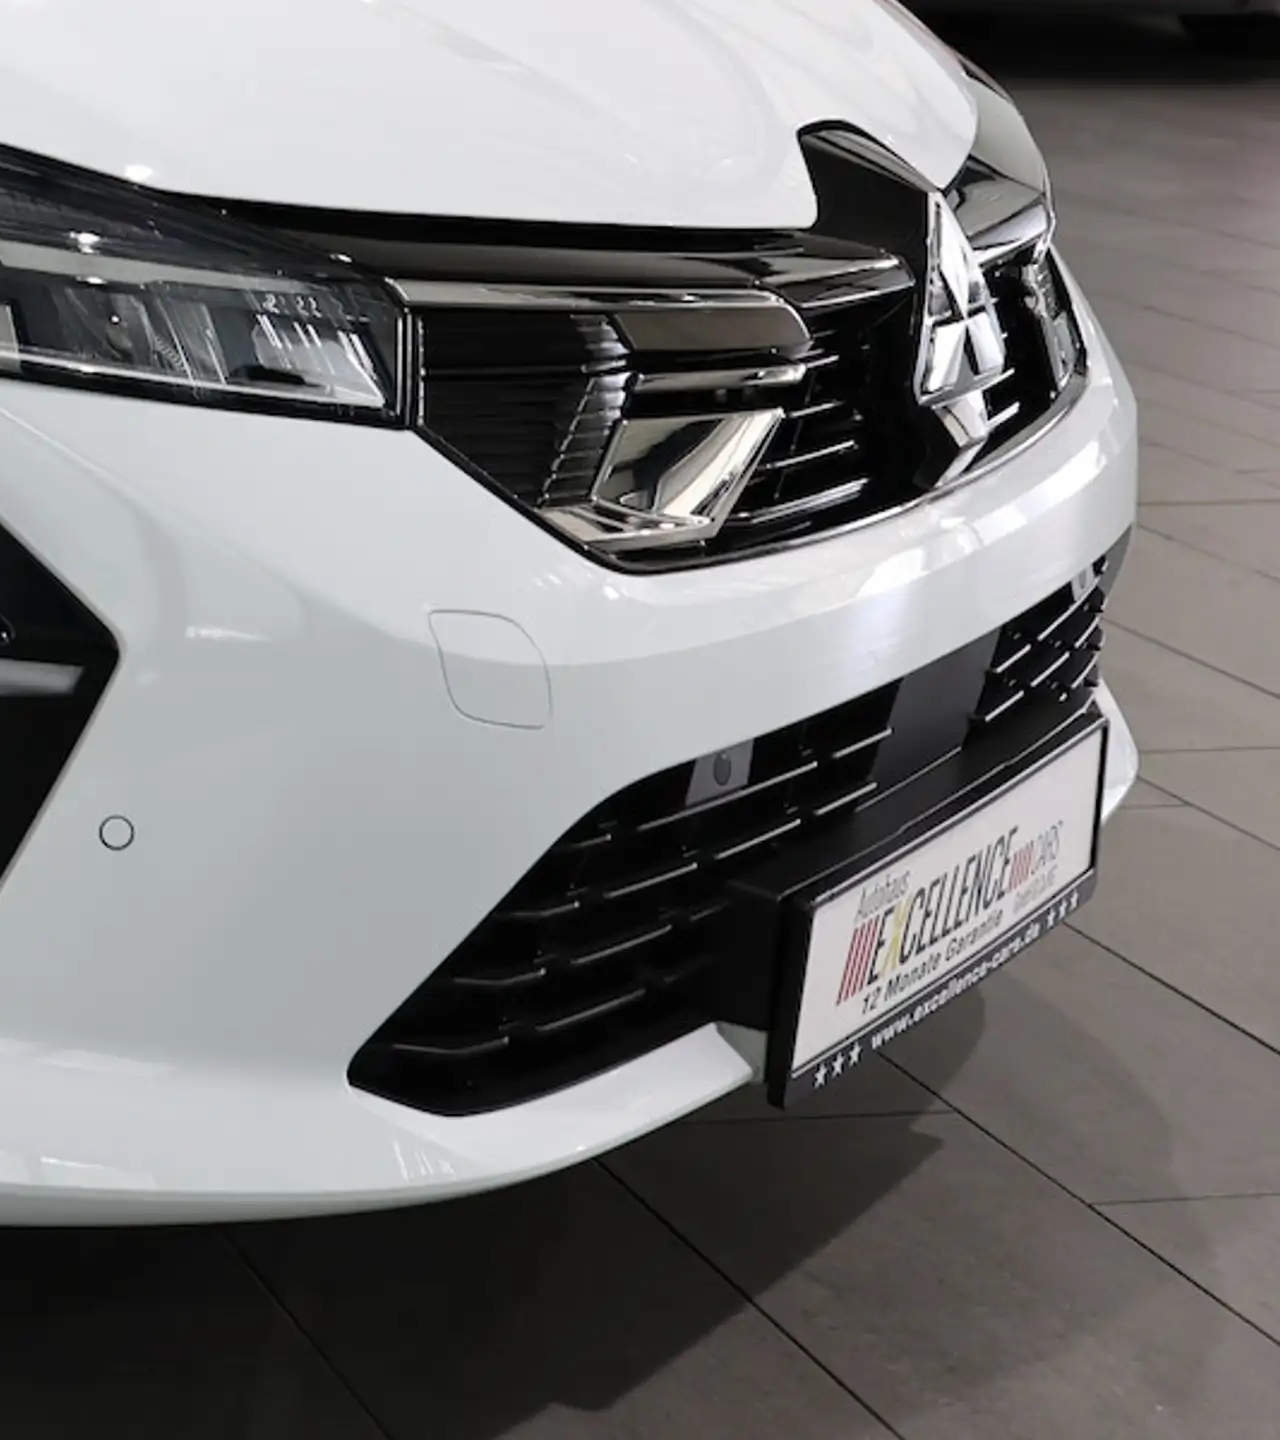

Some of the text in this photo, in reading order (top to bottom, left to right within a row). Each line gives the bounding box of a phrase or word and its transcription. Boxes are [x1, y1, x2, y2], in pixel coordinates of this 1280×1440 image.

[862, 909, 1003, 1015] 12 Monate Garantie
[867, 825, 1018, 985] EXCELLENCE
[871, 922, 1040, 1050] www.excellence-cars.de
